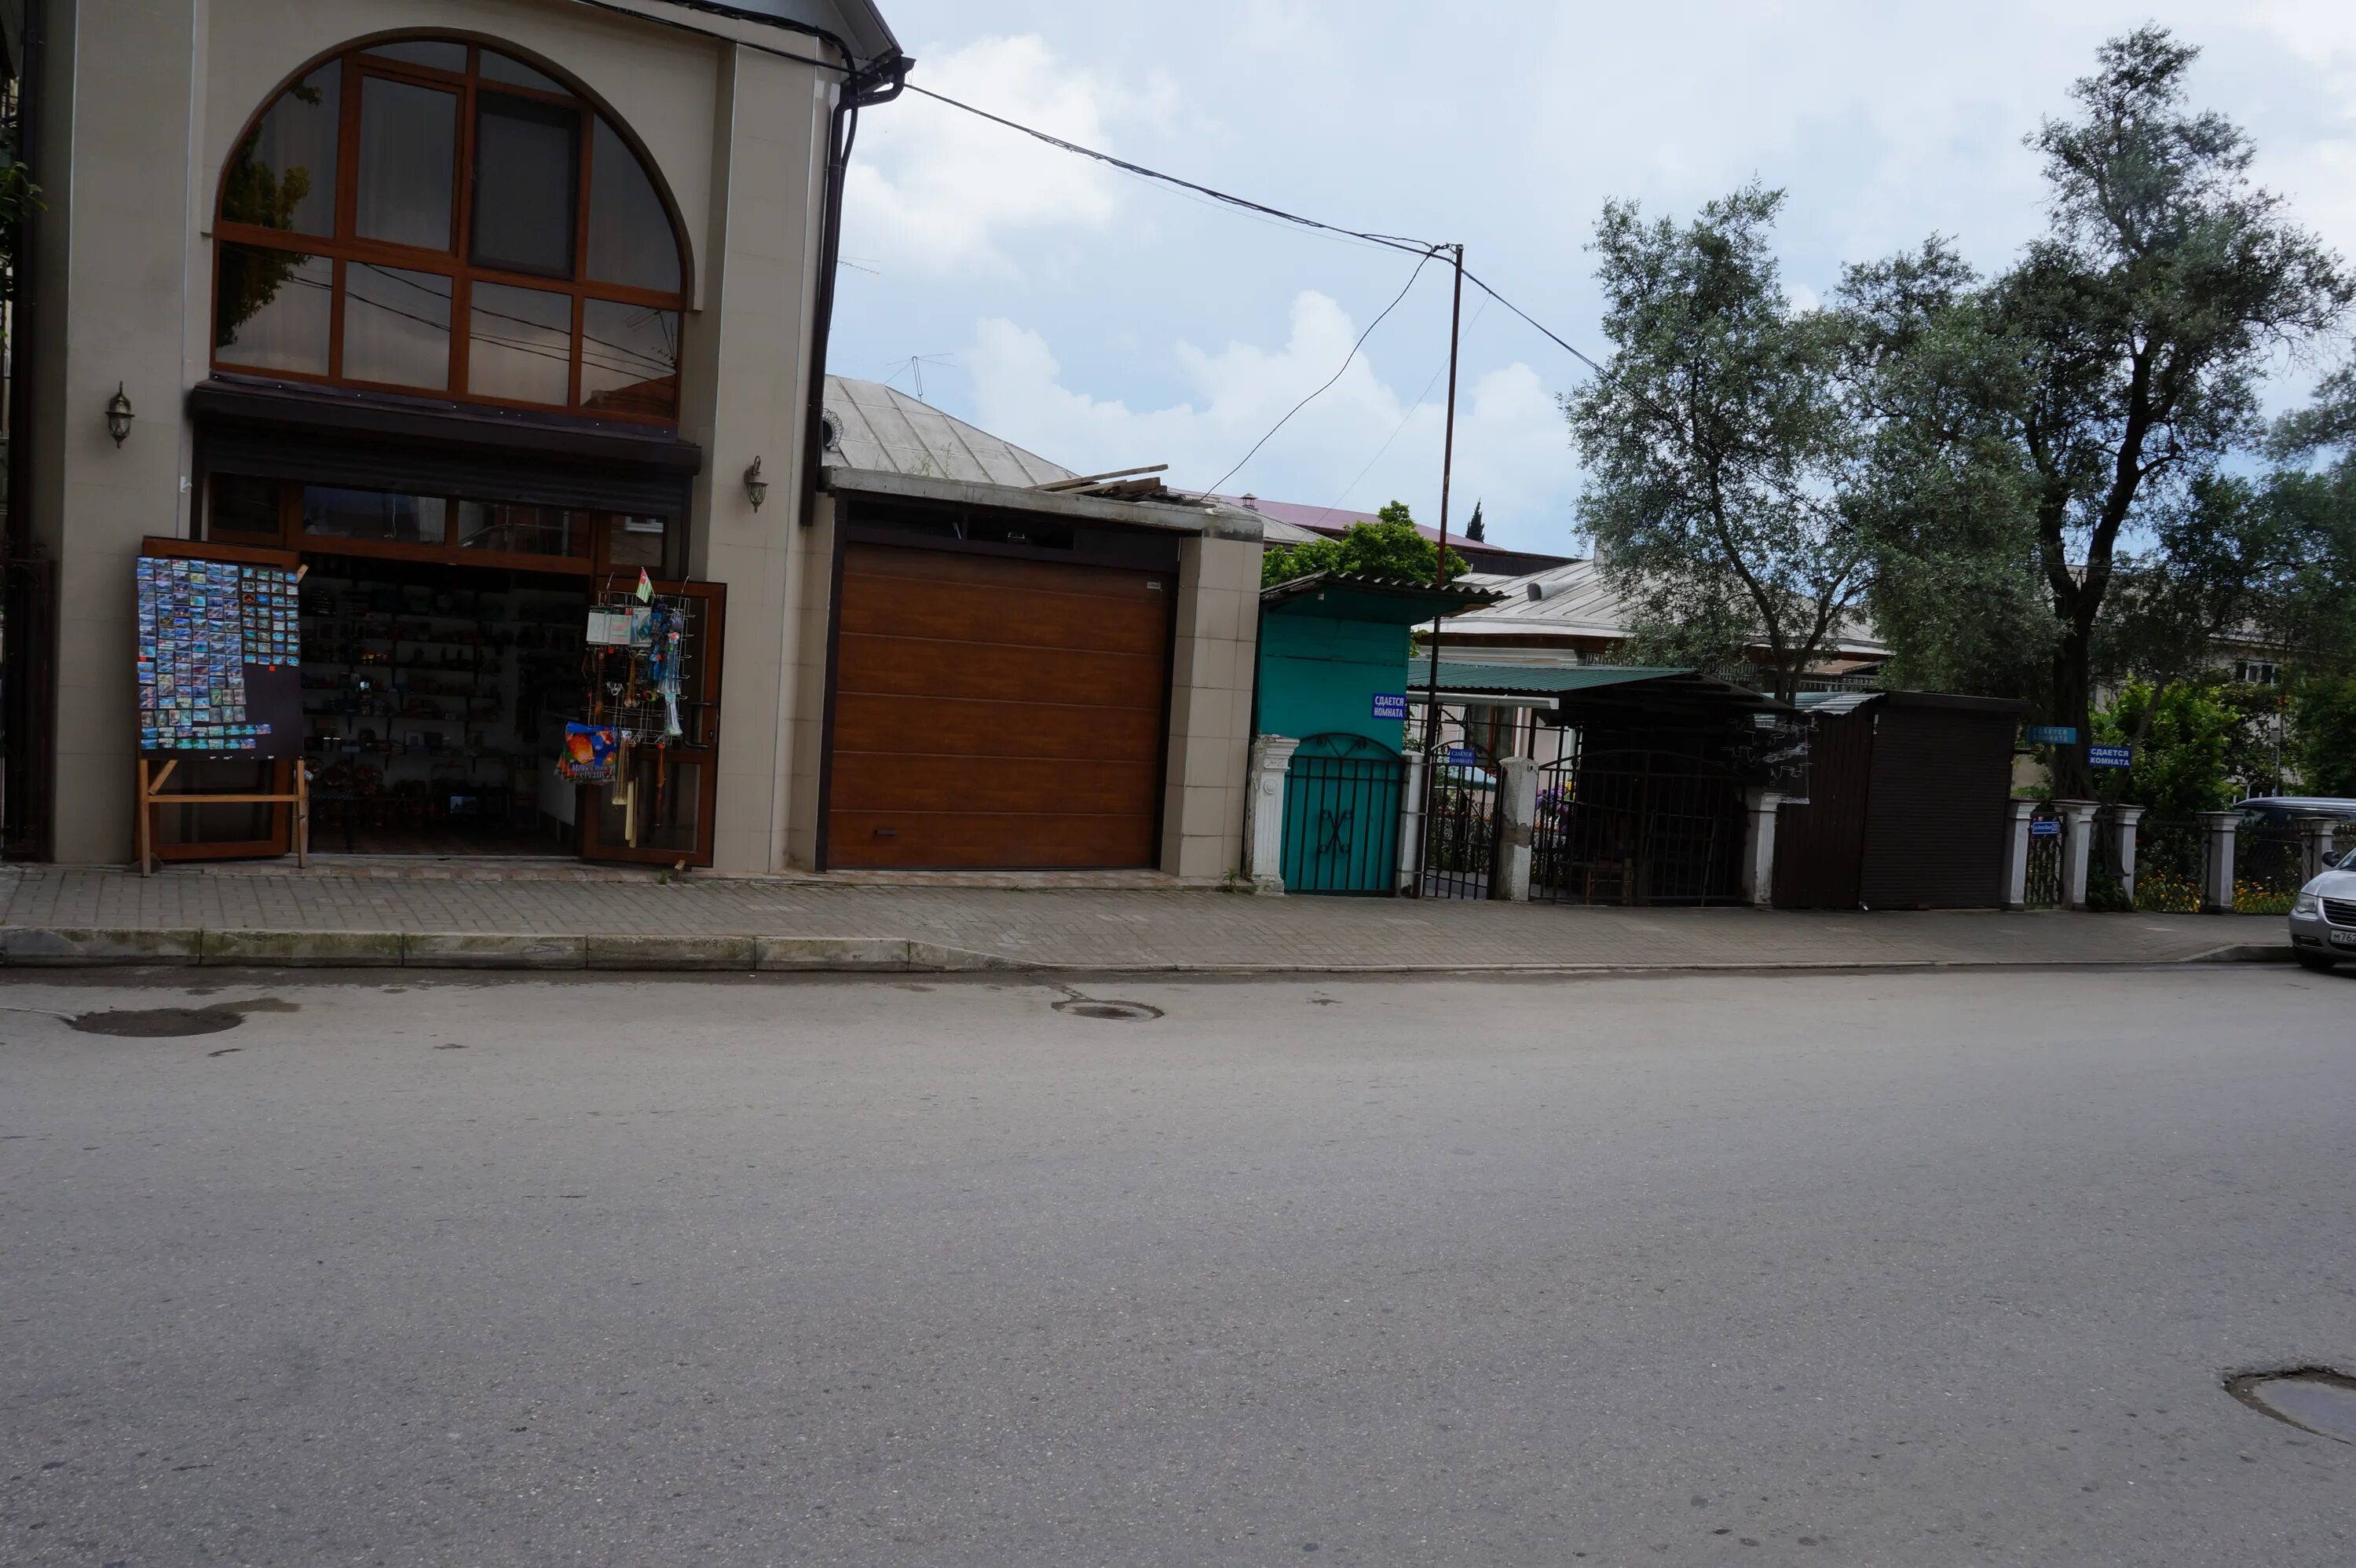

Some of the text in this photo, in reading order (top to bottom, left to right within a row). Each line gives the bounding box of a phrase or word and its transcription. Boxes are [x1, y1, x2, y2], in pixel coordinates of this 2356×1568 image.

[1375, 696, 1404, 706] СДАЕТСЯ
[1374, 707, 1403, 717] КОМНАТА
[2091, 748, 2129, 757] СДАЕТСЯ
[2090, 757, 2130, 766] КОМНАТА
